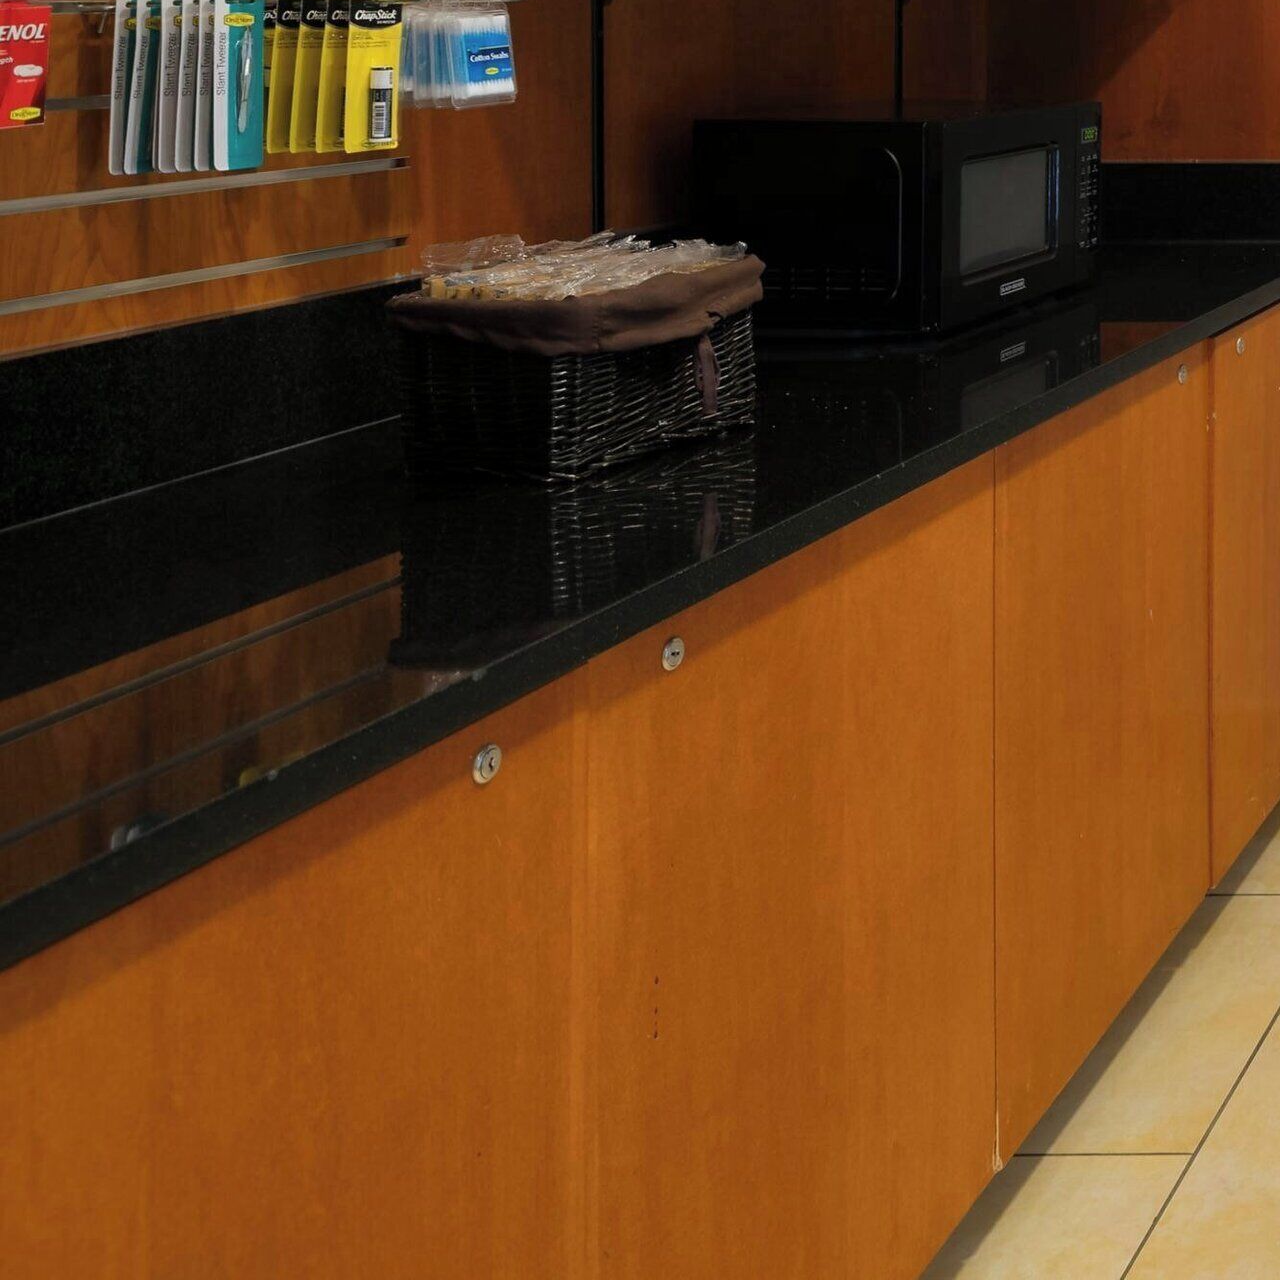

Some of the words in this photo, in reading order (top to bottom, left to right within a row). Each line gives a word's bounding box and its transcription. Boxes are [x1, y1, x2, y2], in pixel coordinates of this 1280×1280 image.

[355, 9, 396, 20] ChapStick
[217, 32, 226, 70] Tweezer
[216, 72, 226, 96] Slant
